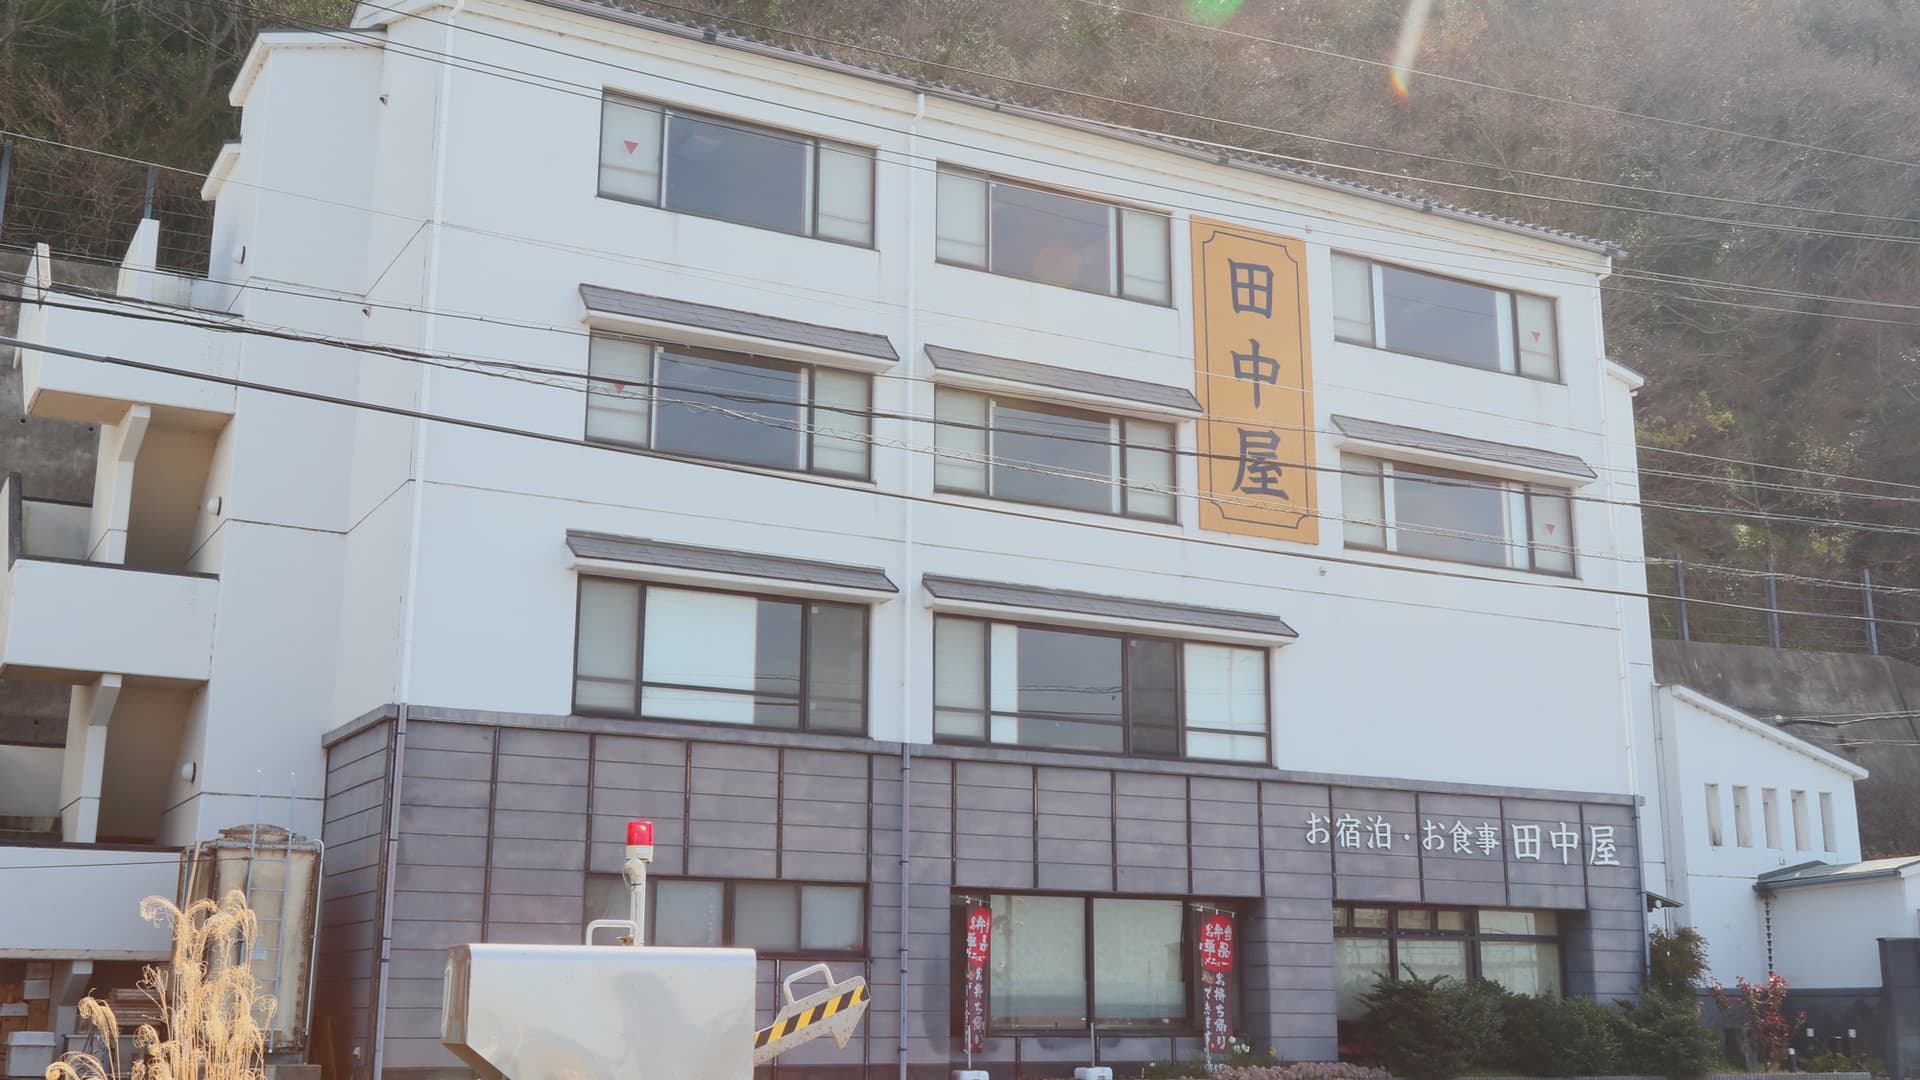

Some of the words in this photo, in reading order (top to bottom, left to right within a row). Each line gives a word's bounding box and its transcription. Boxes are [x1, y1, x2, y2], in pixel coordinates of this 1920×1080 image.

[1227, 257, 1289, 501] 田中屋
[1511, 822, 1620, 866] 田中屋
[1213, 972, 1228, 1051] お持ち帰り
